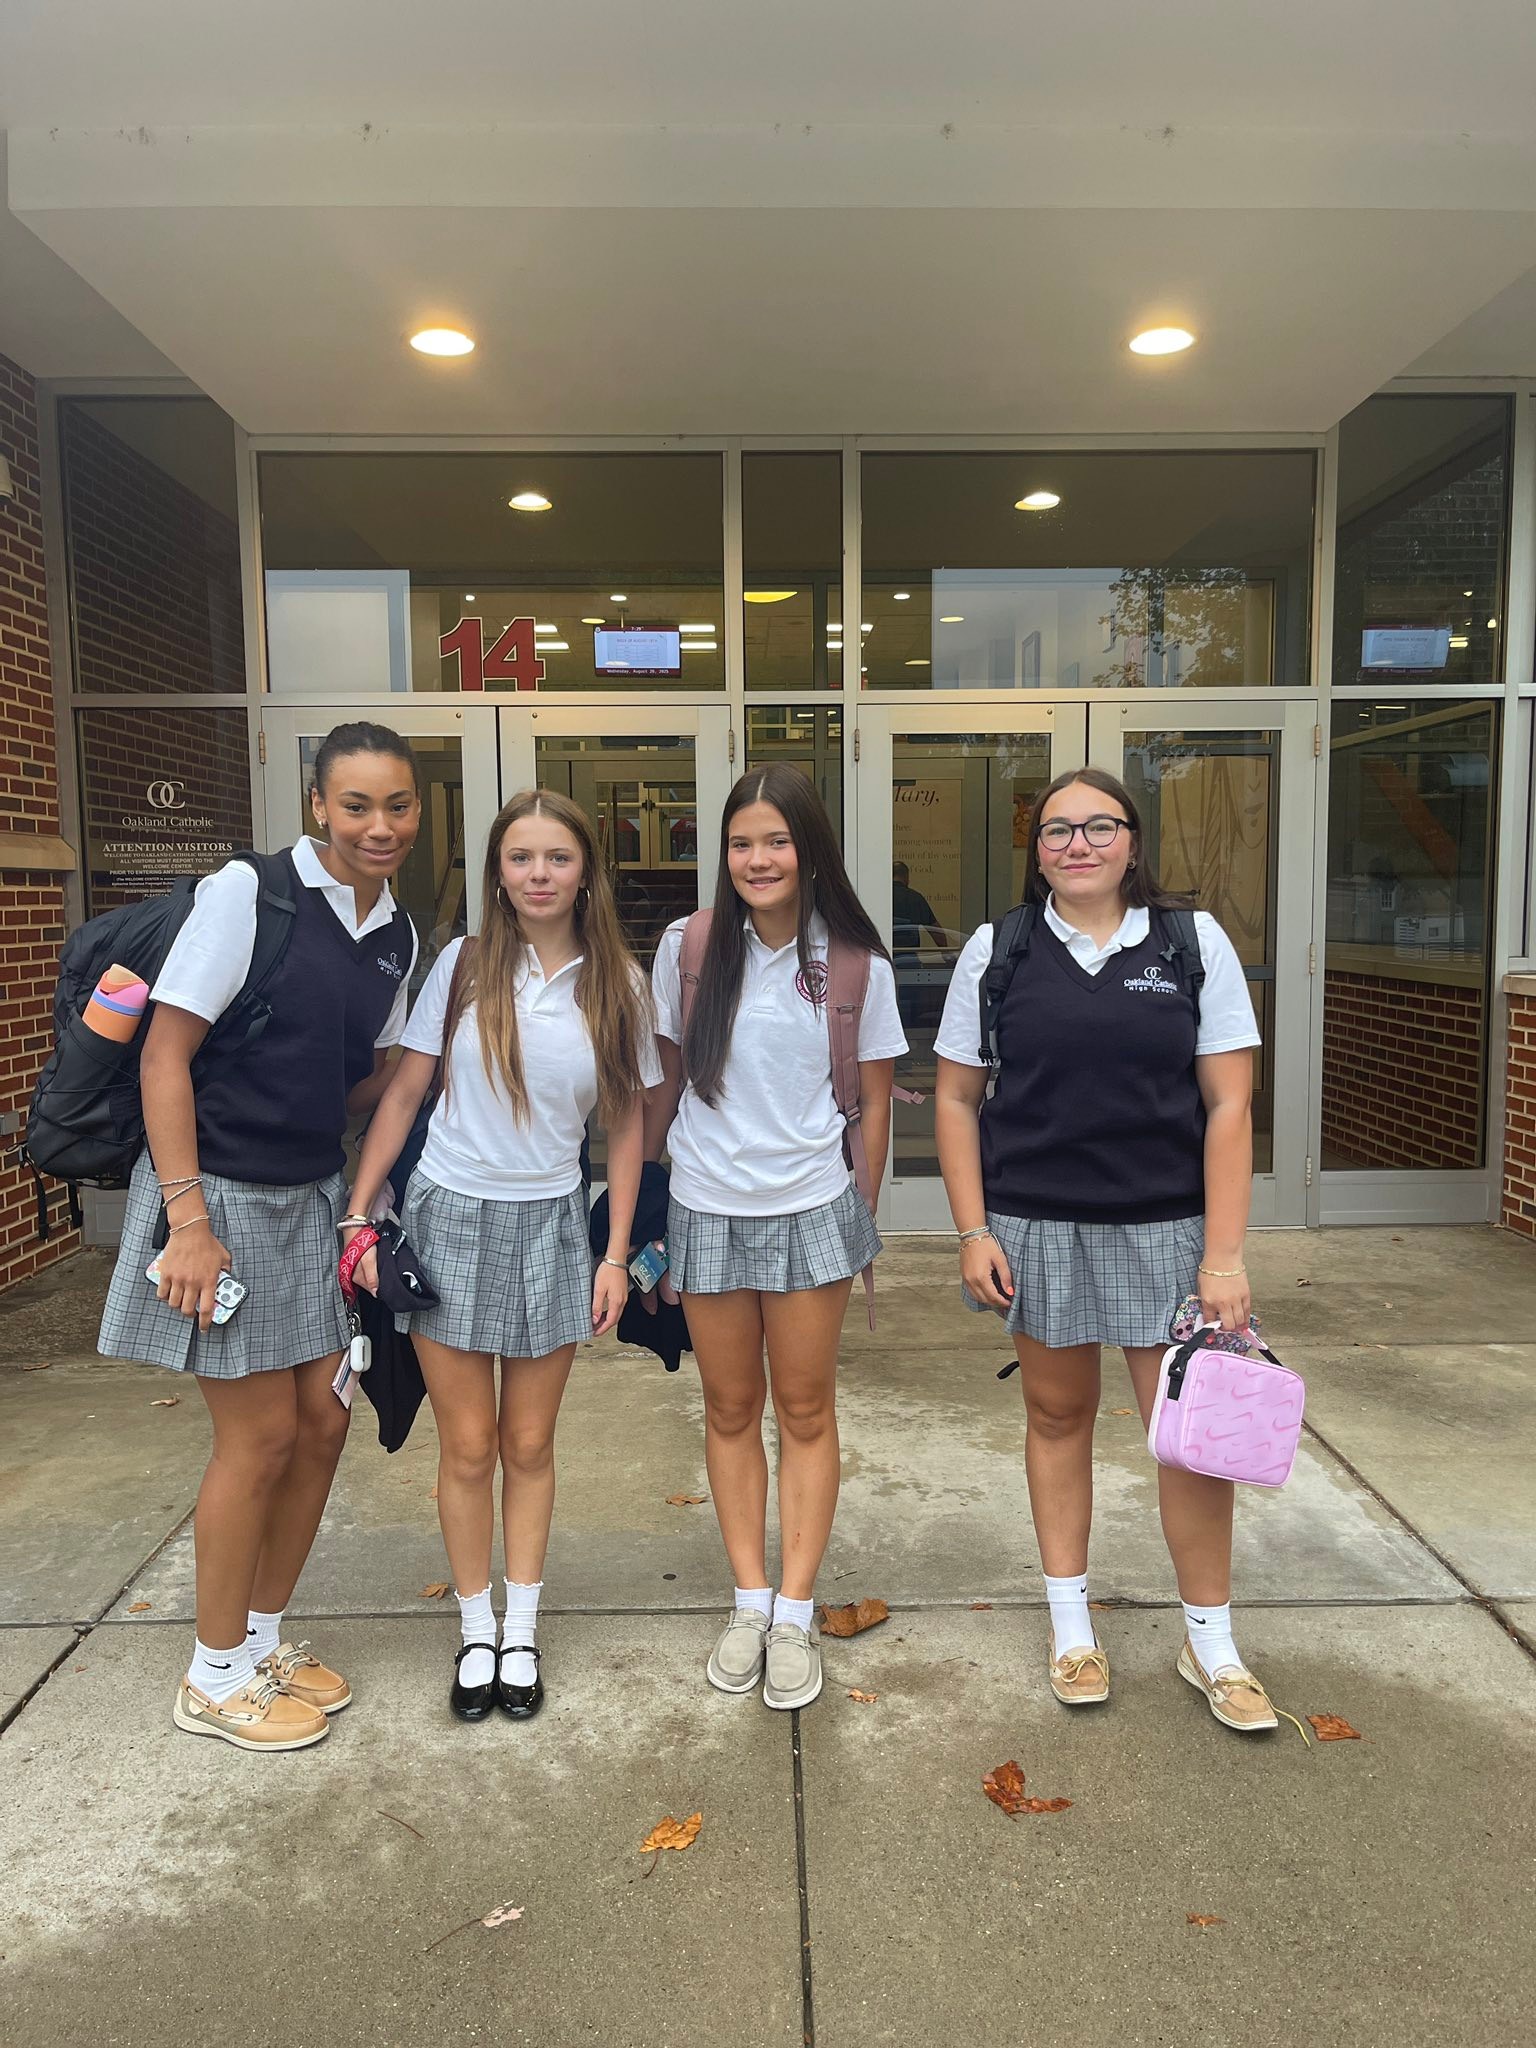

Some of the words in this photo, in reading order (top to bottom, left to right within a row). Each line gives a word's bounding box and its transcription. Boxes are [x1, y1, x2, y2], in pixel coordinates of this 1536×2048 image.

[439, 617, 546, 692] 14
[122, 816, 167, 827] Oakland
[170, 816, 214, 827] Catholic
[103, 843, 174, 852] ATTENTION
[176, 842, 233, 852] VISITORS
